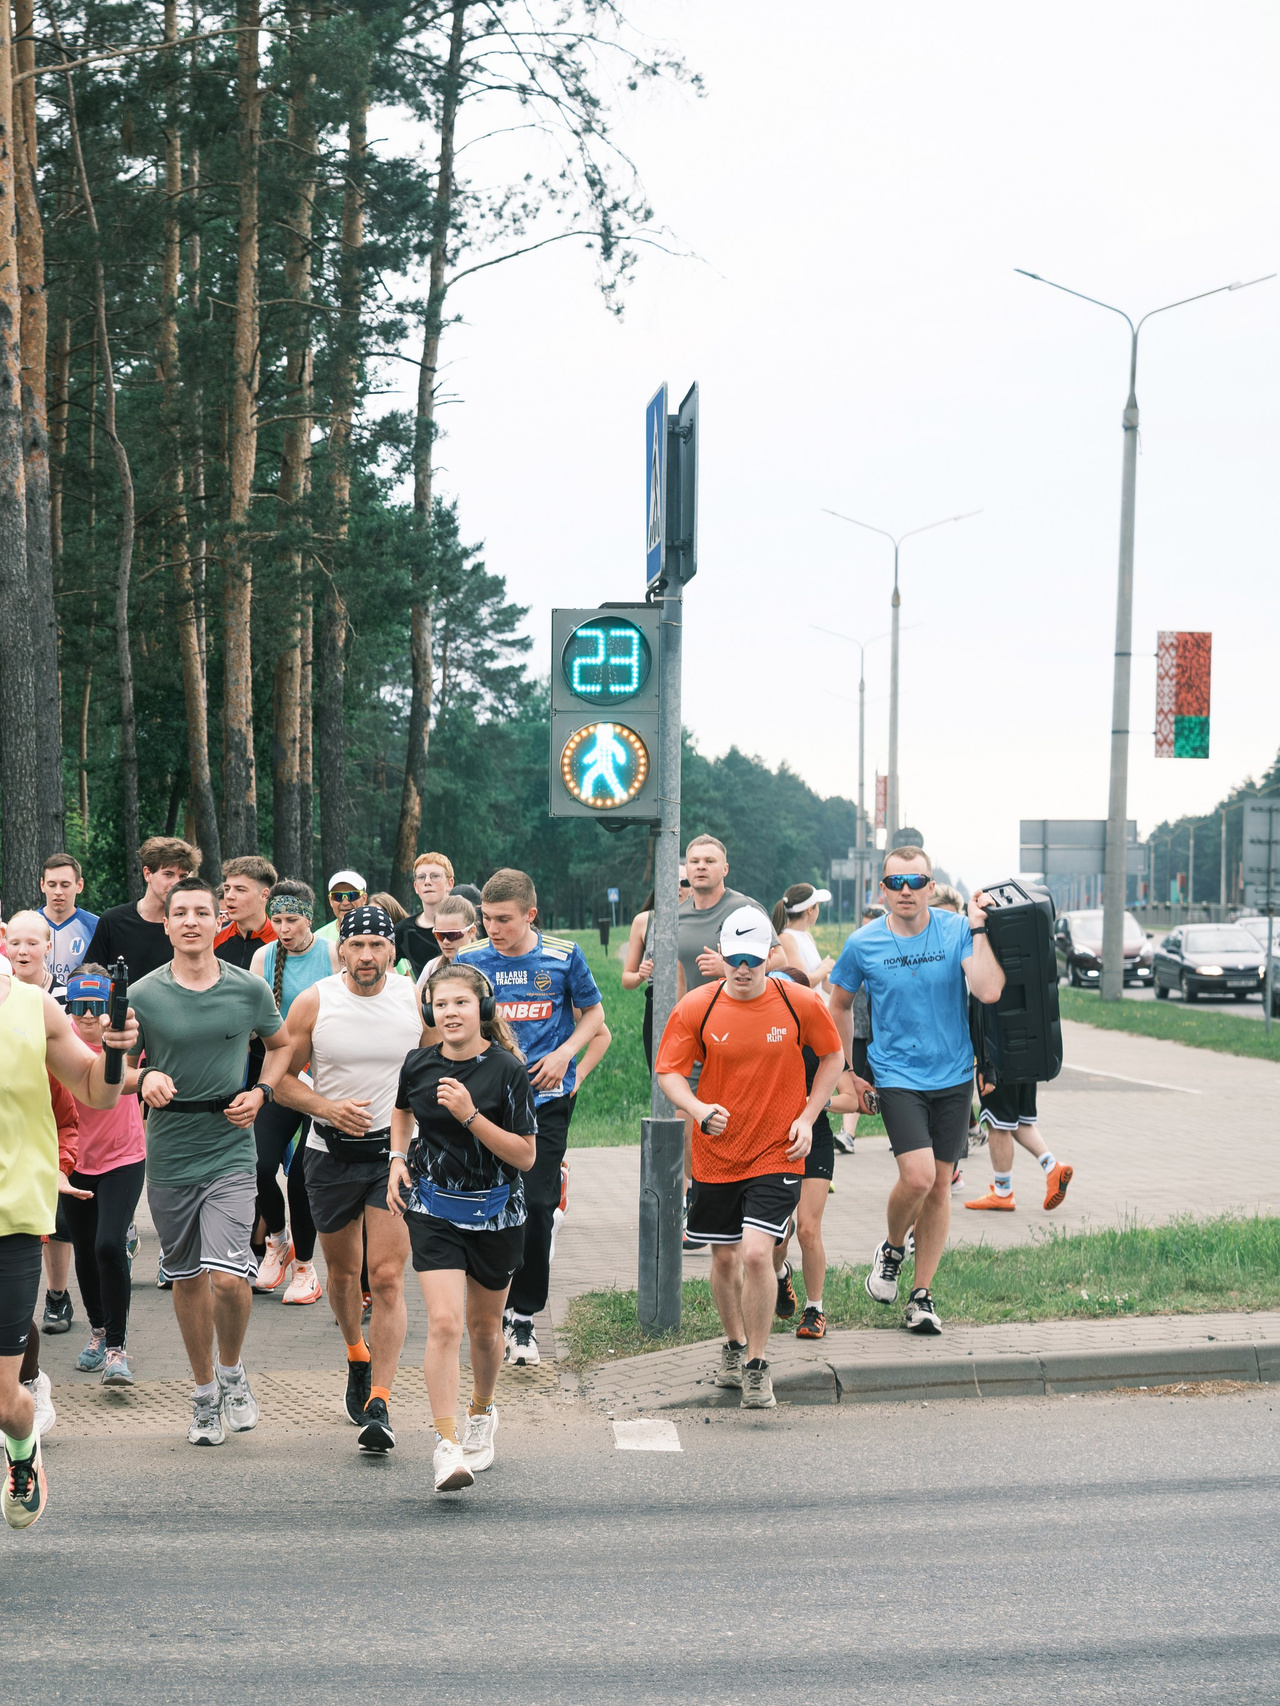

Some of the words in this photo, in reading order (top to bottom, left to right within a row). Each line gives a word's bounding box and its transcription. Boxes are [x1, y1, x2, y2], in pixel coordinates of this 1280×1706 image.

[573, 628, 639, 693] 23
[495, 970, 528, 979] BELARUS
[495, 978, 528, 986] TRACTORS
[771, 1026, 787, 1036] One
[766, 1033, 782, 1043] Run
